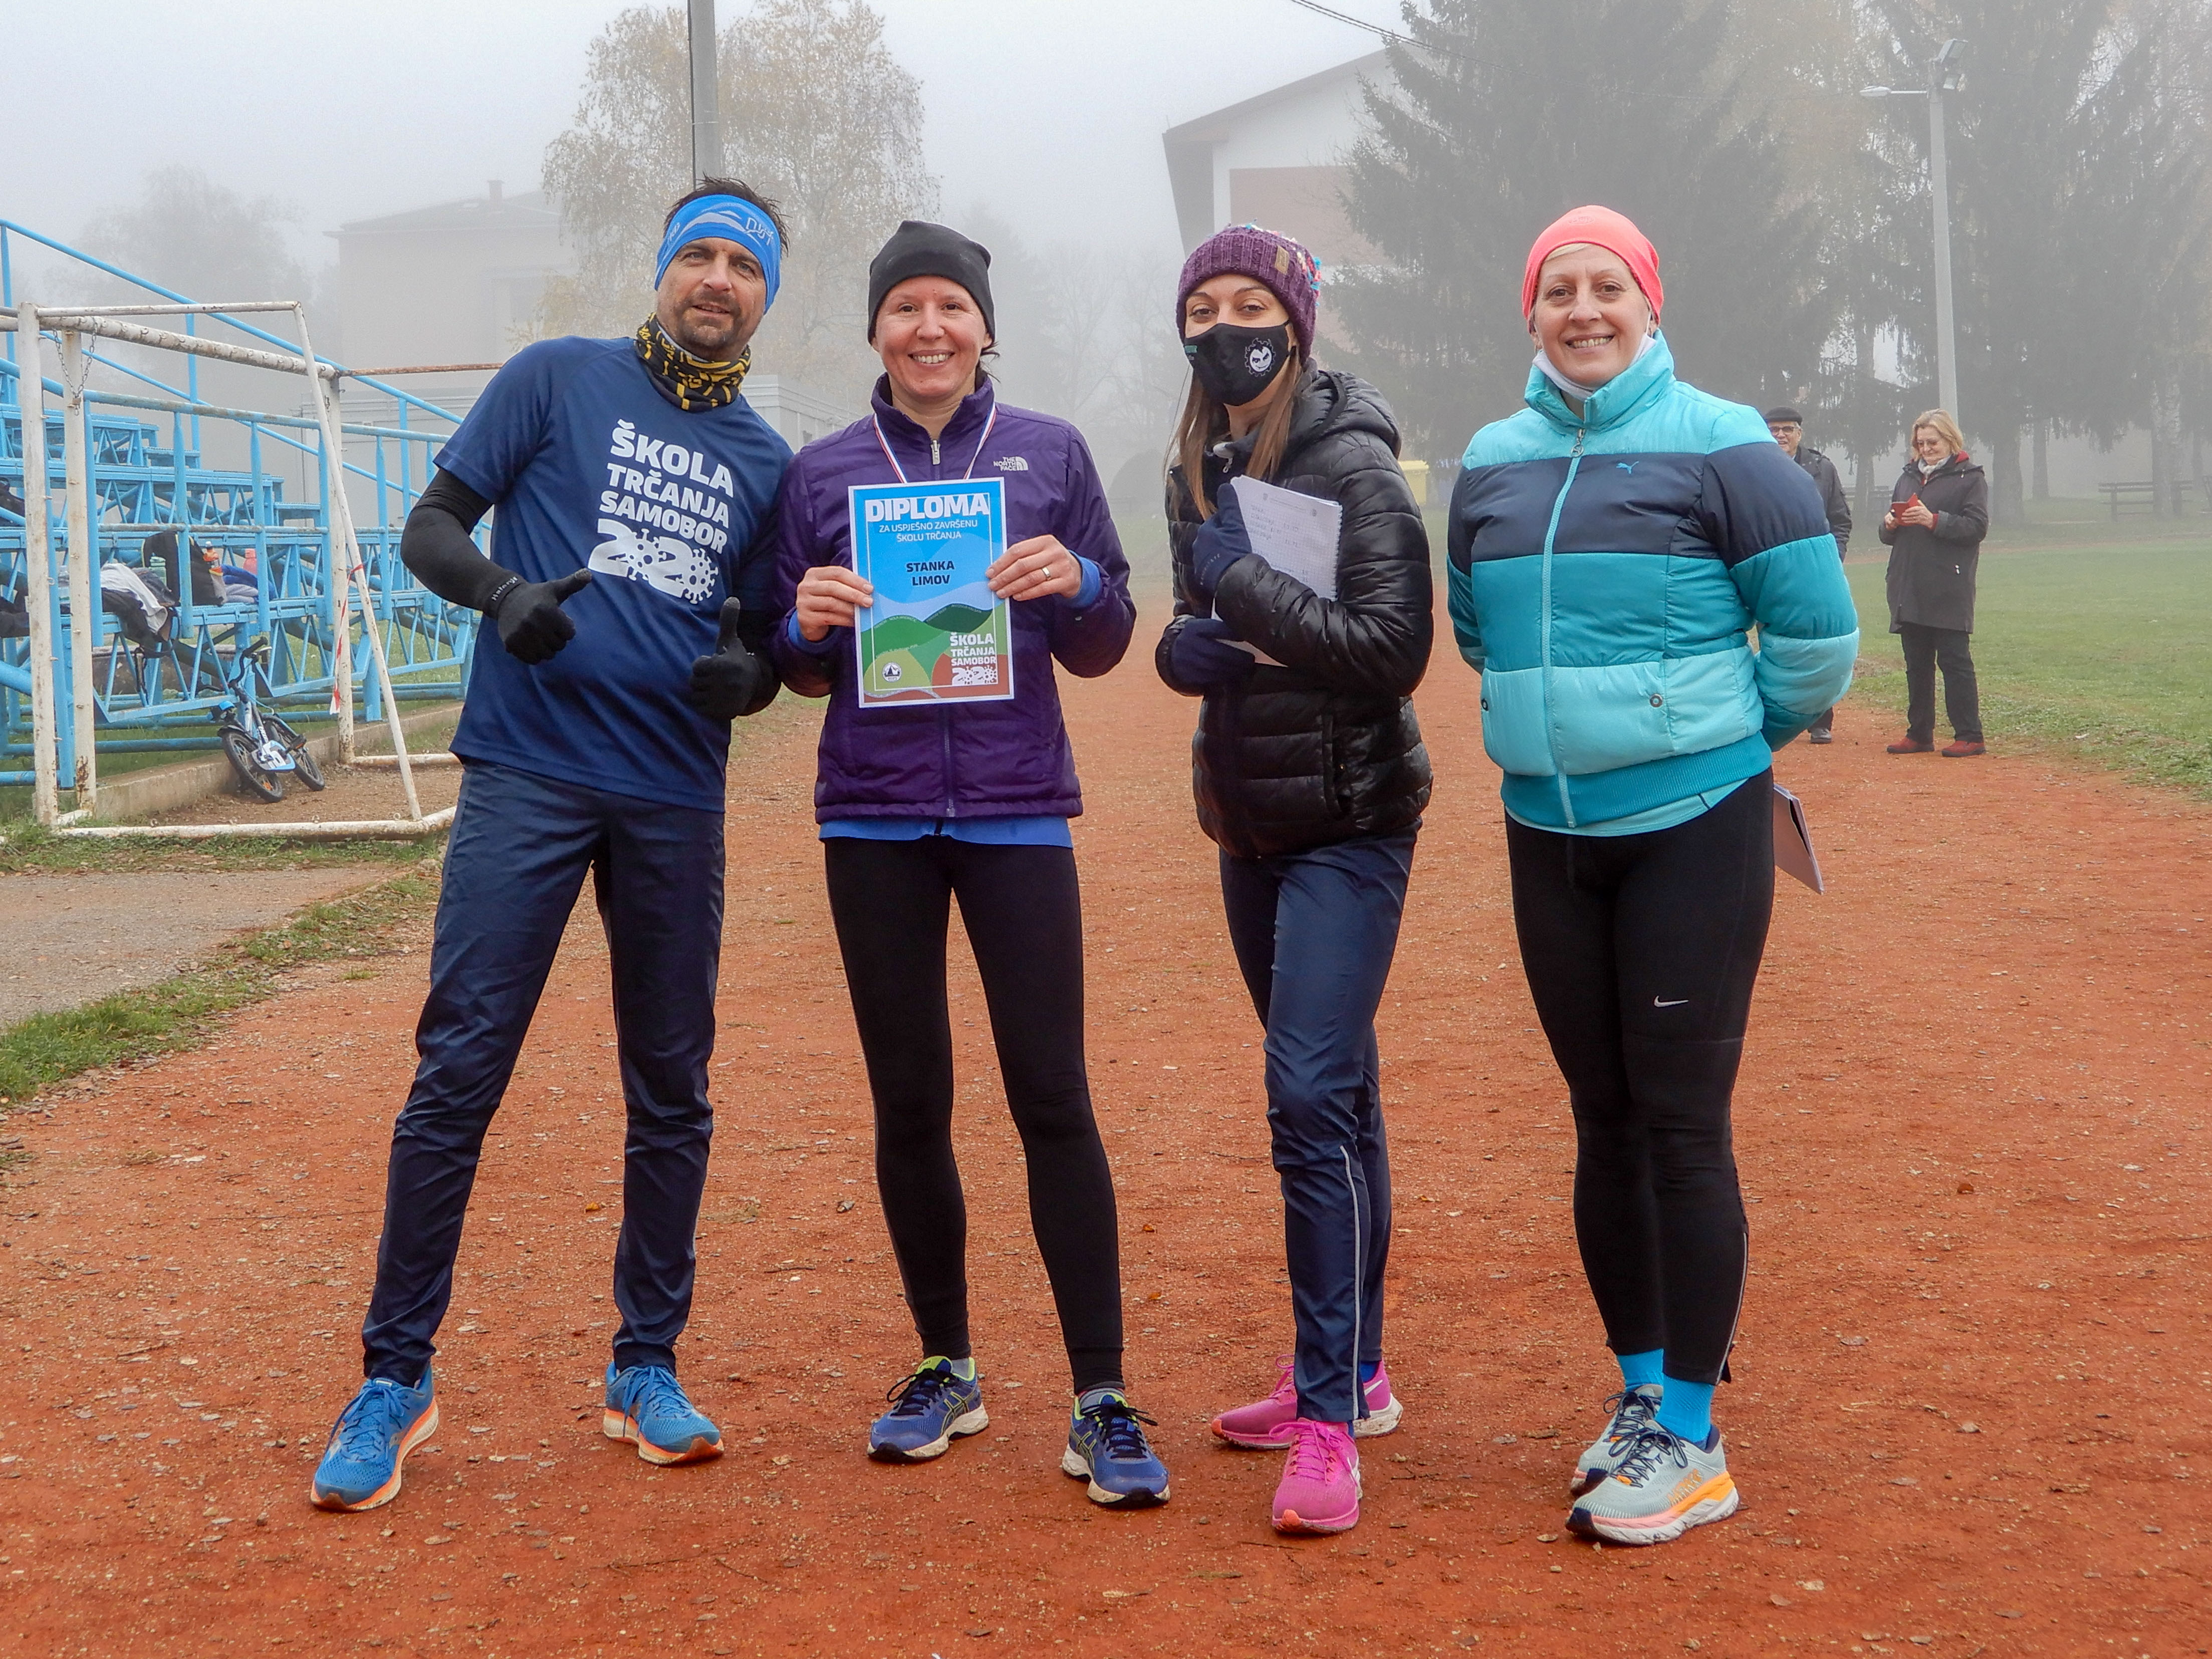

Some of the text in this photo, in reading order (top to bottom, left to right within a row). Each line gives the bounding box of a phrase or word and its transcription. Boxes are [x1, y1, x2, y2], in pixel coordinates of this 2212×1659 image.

[610, 419, 734, 498] ŠKOLA
[607, 463, 729, 528] TRČANJA
[865, 494, 990, 522] DIPLOMA
[599, 491, 727, 554] SAMOBOR
[879, 520, 977, 533] ZA USPJEŠNO ZAVRŠENU
[897, 531, 961, 542] ŠKOLU TRČANJA
[906, 561, 954, 572] STANKA
[912, 575, 950, 586] LIMOV
[949, 632, 994, 646] ŠKOLA
[950, 646, 995, 657] TRČANJA
[951, 656, 996, 666] SAMOBOR
